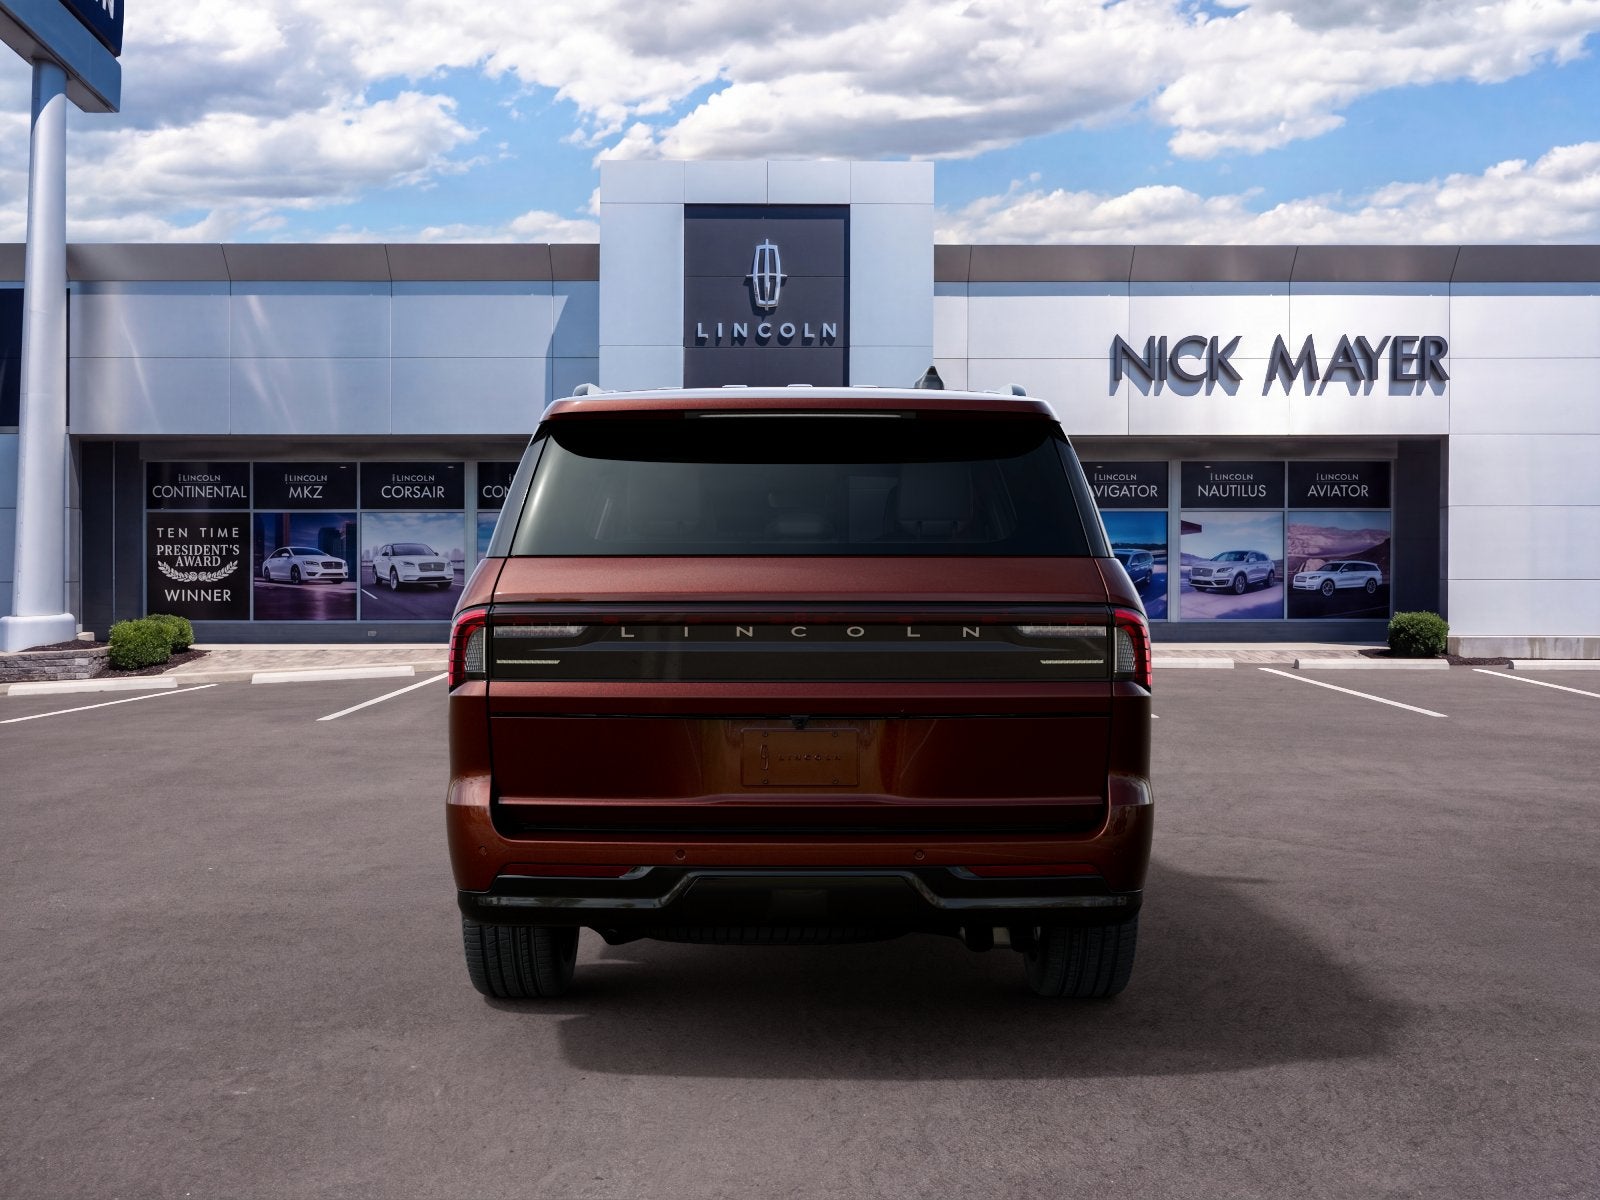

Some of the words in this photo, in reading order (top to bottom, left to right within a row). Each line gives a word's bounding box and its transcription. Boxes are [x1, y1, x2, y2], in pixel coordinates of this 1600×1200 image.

[697, 322, 837, 338] LINCOLN
[1112, 333, 1243, 381] NICK
[1267, 333, 1450, 381] MAYER
[182, 474, 221, 482] LINCOLN
[289, 474, 328, 482] LINCOLN
[396, 474, 435, 482] LINCOLN
[1098, 473, 1137, 481] LINCOLN
[1215, 473, 1254, 481] LINCOLN
[1320, 473, 1359, 481] LINCOLN
[152, 485, 247, 498] CONTINENTAL
[288, 485, 323, 499] MKZ
[381, 485, 445, 498] CORSAIR
[1197, 484, 1267, 497] NAUTILUS
[1307, 484, 1369, 497] AVIATOR
[156, 527, 188, 538] TEN
[200, 527, 240, 538] TIME
[156, 544, 240, 556] PRESIDENT'S
[175, 555, 221, 567] AWARD
[164, 589, 232, 602] WINNER
[620, 626, 981, 638] LINCOLN
